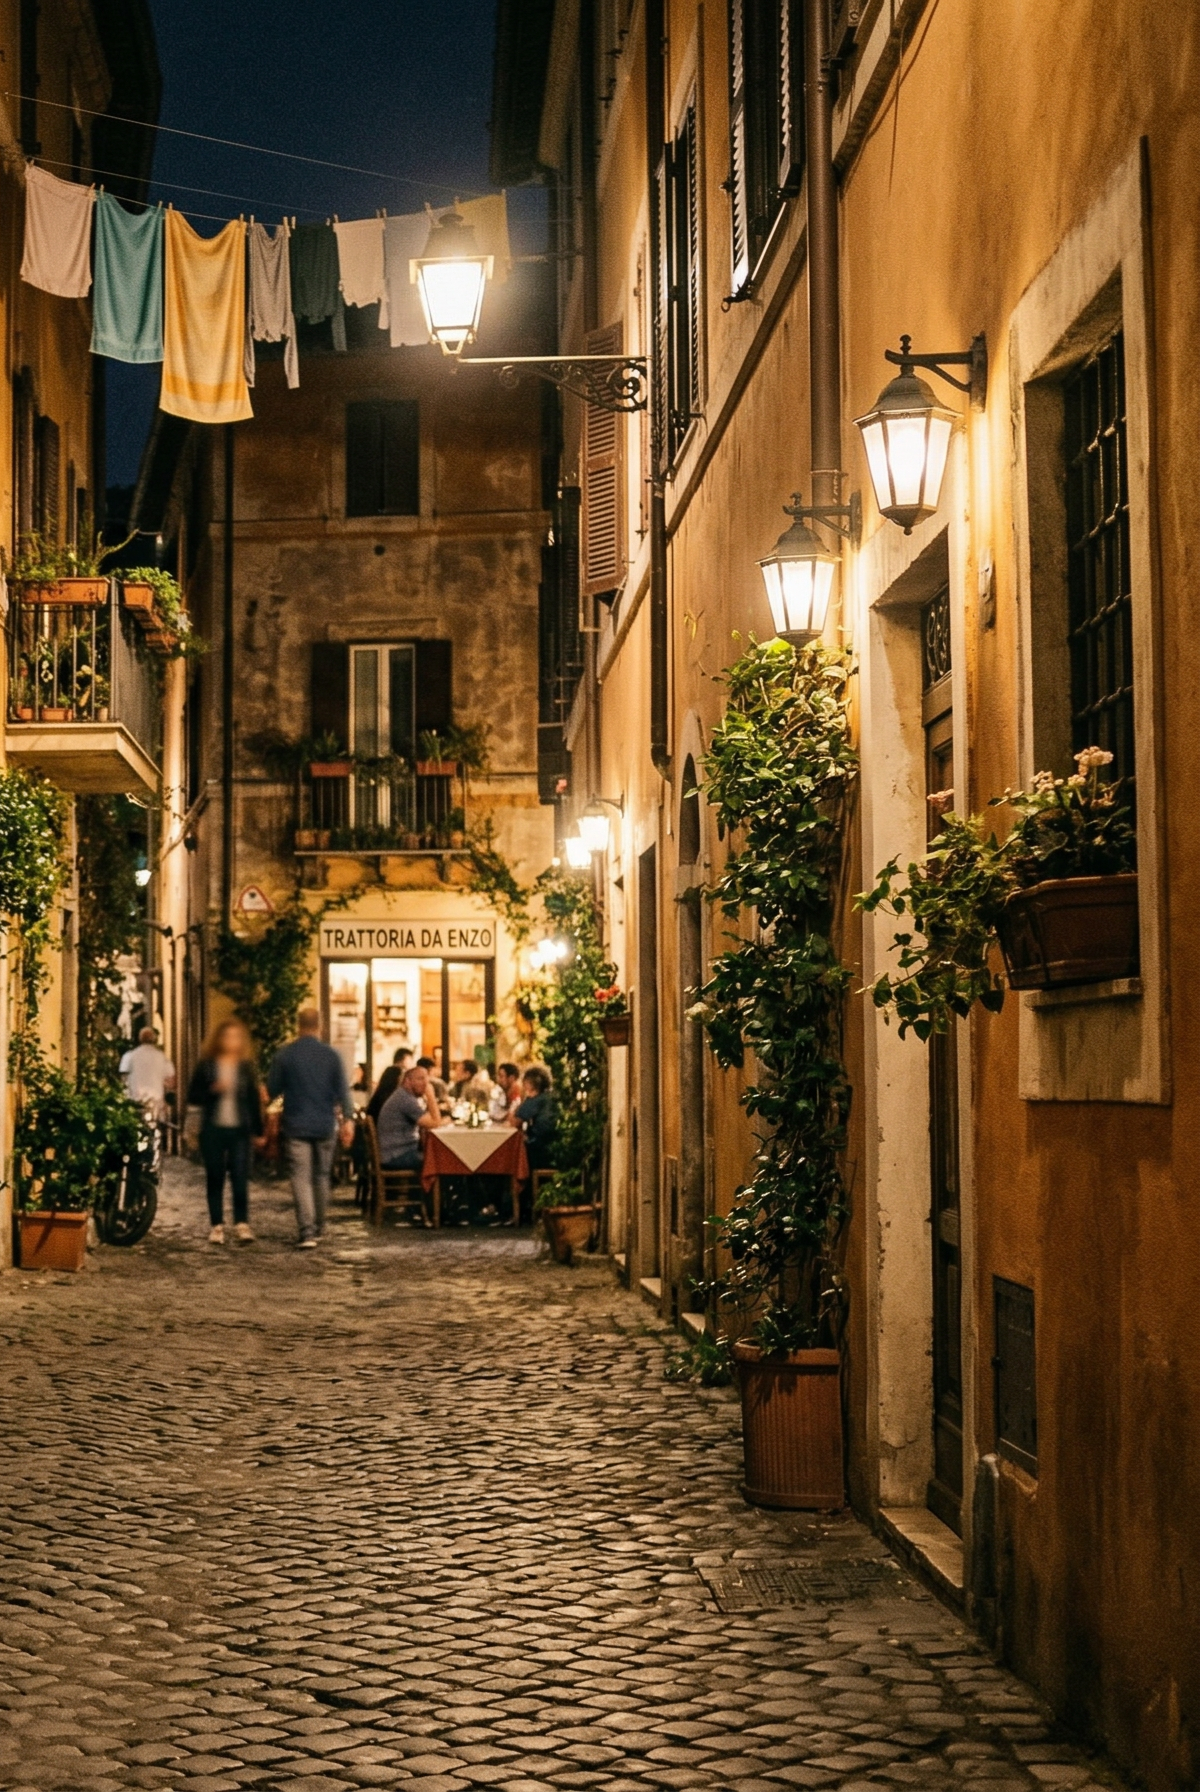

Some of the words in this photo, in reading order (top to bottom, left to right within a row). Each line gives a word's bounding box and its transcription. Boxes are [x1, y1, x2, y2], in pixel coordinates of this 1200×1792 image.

[323, 928, 416, 949] TRATTORIA
[420, 928, 443, 949] DA
[447, 928, 492, 949] ENZO
